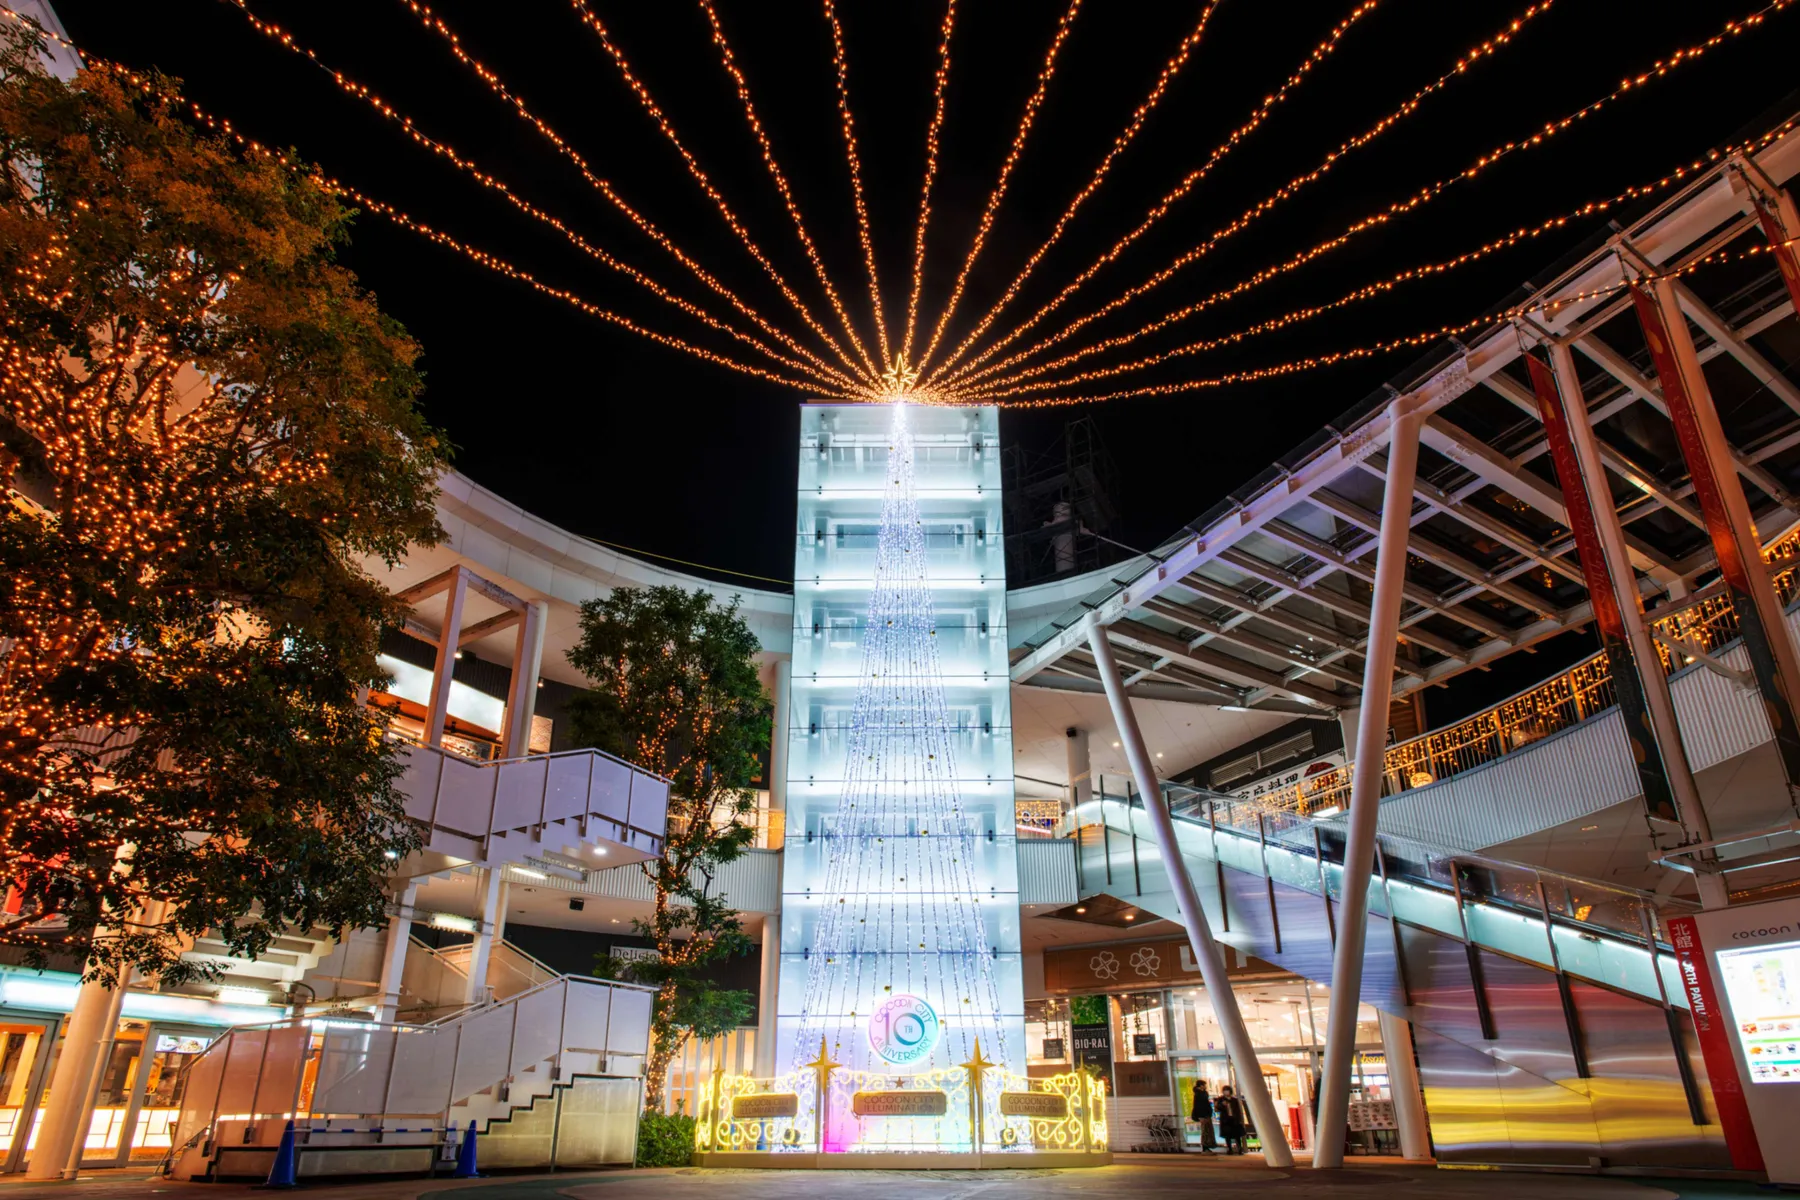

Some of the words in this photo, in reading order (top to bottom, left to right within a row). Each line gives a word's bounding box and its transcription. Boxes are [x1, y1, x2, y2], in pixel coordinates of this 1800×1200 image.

[1672, 923, 1694, 949] 北館
[1732, 925, 1791, 940] cocoon
[1680, 951, 1699, 985] NORTH
[874, 998, 913, 1023] COCOON
[914, 1003, 933, 1023] CITY
[1689, 987, 1711, 1032] PAVILION
[883, 1012, 925, 1046] 10
[904, 1025, 913, 1034] TH
[874, 1036, 933, 1061] ANNIVERSARY
[1074, 1038, 1109, 1049] BIO-RAL
[863, 1095, 910, 1104] COCOON
[913, 1095, 935, 1104] CITY
[864, 1104, 936, 1113] ILLUMINATION
[1008, 1096, 1041, 1105] COCOON
